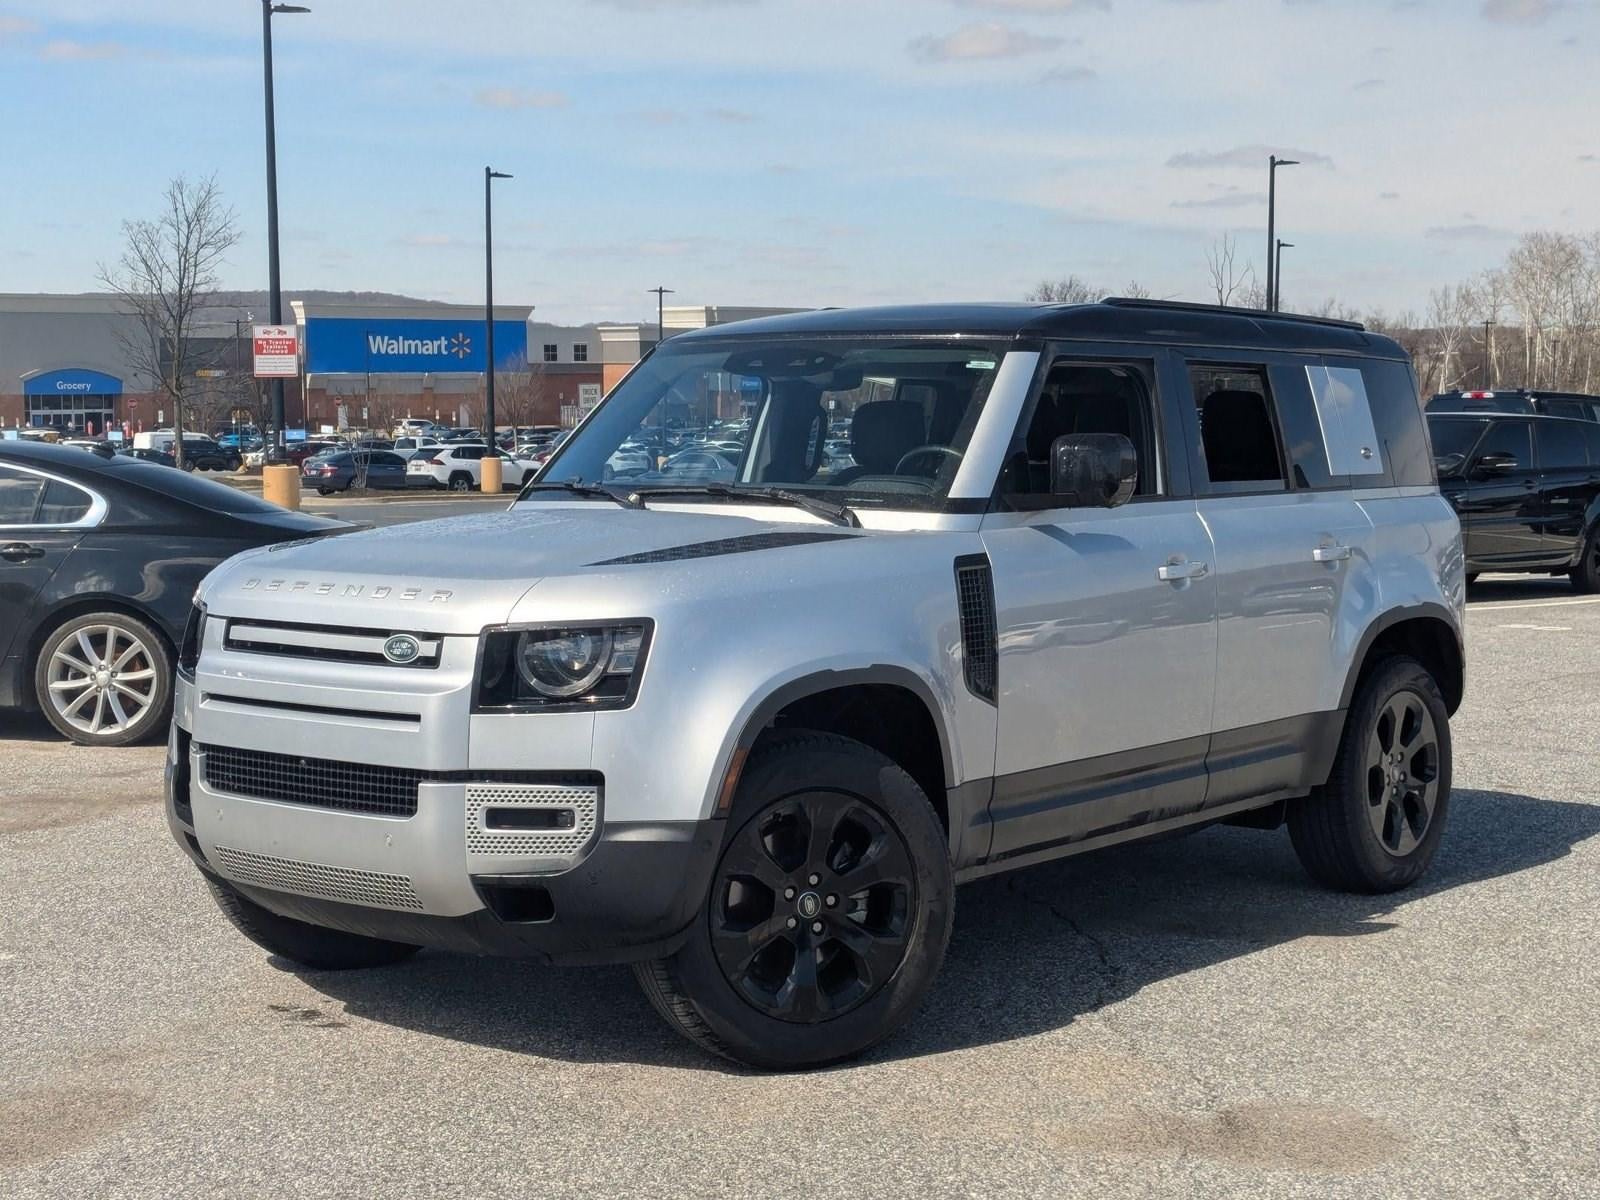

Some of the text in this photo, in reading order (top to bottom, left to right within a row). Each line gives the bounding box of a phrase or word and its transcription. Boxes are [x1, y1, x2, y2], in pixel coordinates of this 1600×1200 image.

[368, 335, 448, 355] Walmart
[56, 381, 91, 392] Grocery
[241, 578, 454, 603] DEFENDER
